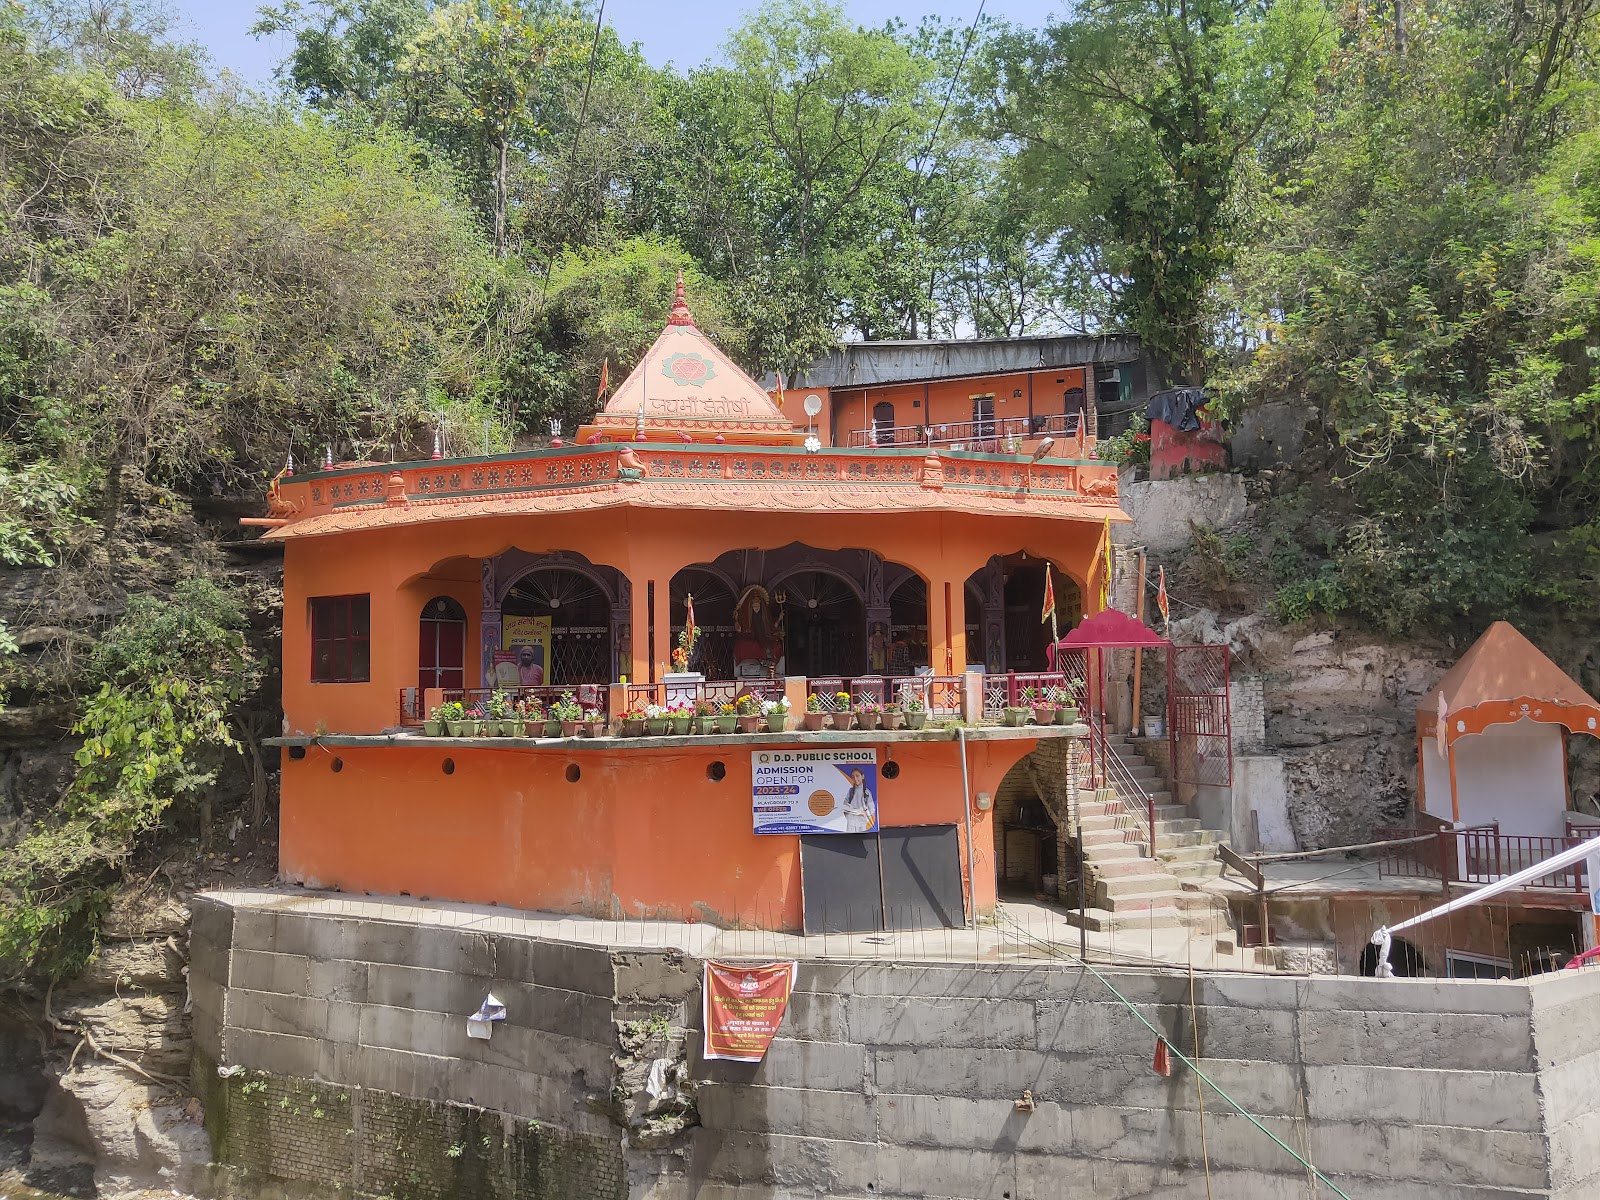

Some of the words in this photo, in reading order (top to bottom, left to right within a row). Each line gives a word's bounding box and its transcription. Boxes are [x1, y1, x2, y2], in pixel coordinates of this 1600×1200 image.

[699, 396, 751, 414] संतोषी
[774, 754, 794, 762] D.D.
[796, 753, 831, 761] PUBLIC
[834, 752, 873, 761] SCHOOL
[756, 766, 813, 775] ADMISSION
[757, 776, 788, 785] OPEN
[792, 776, 814, 784] FOR
[757, 786, 796, 794] 2023-24
